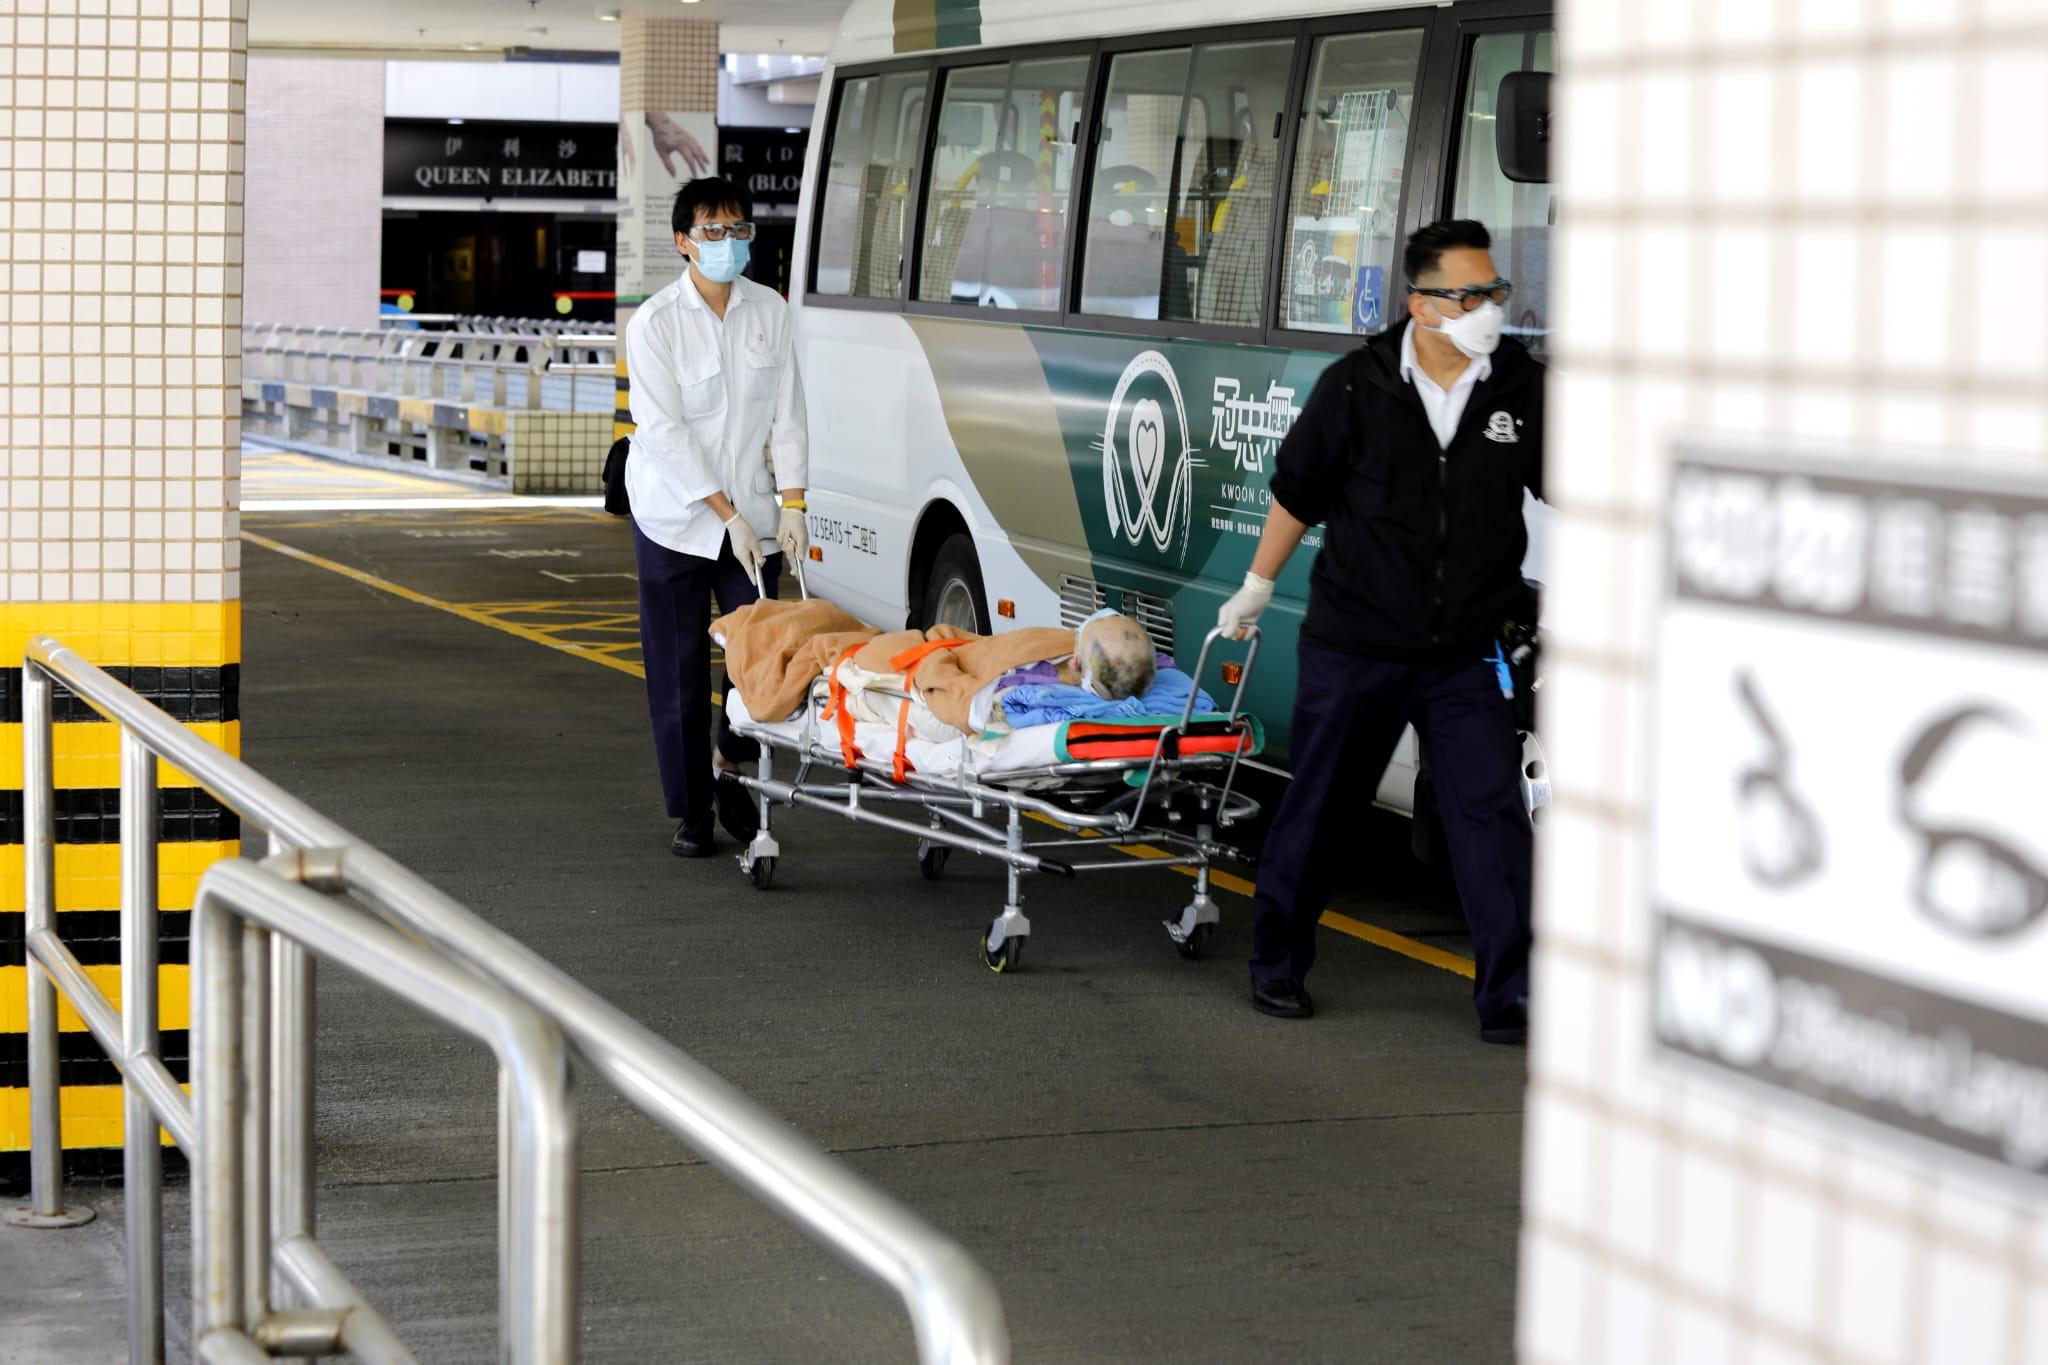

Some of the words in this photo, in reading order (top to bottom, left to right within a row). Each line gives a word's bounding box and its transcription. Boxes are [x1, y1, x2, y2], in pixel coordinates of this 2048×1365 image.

[415, 166, 491, 187] QUEEN
[748, 173, 803, 194] (BLO
[1221, 482, 1255, 504] KWOON
[1259, 489, 1276, 507] CH
[810, 515, 819, 538] 12
[820, 518, 842, 544] SEATS
[845, 521, 877, 555] 十二座位
